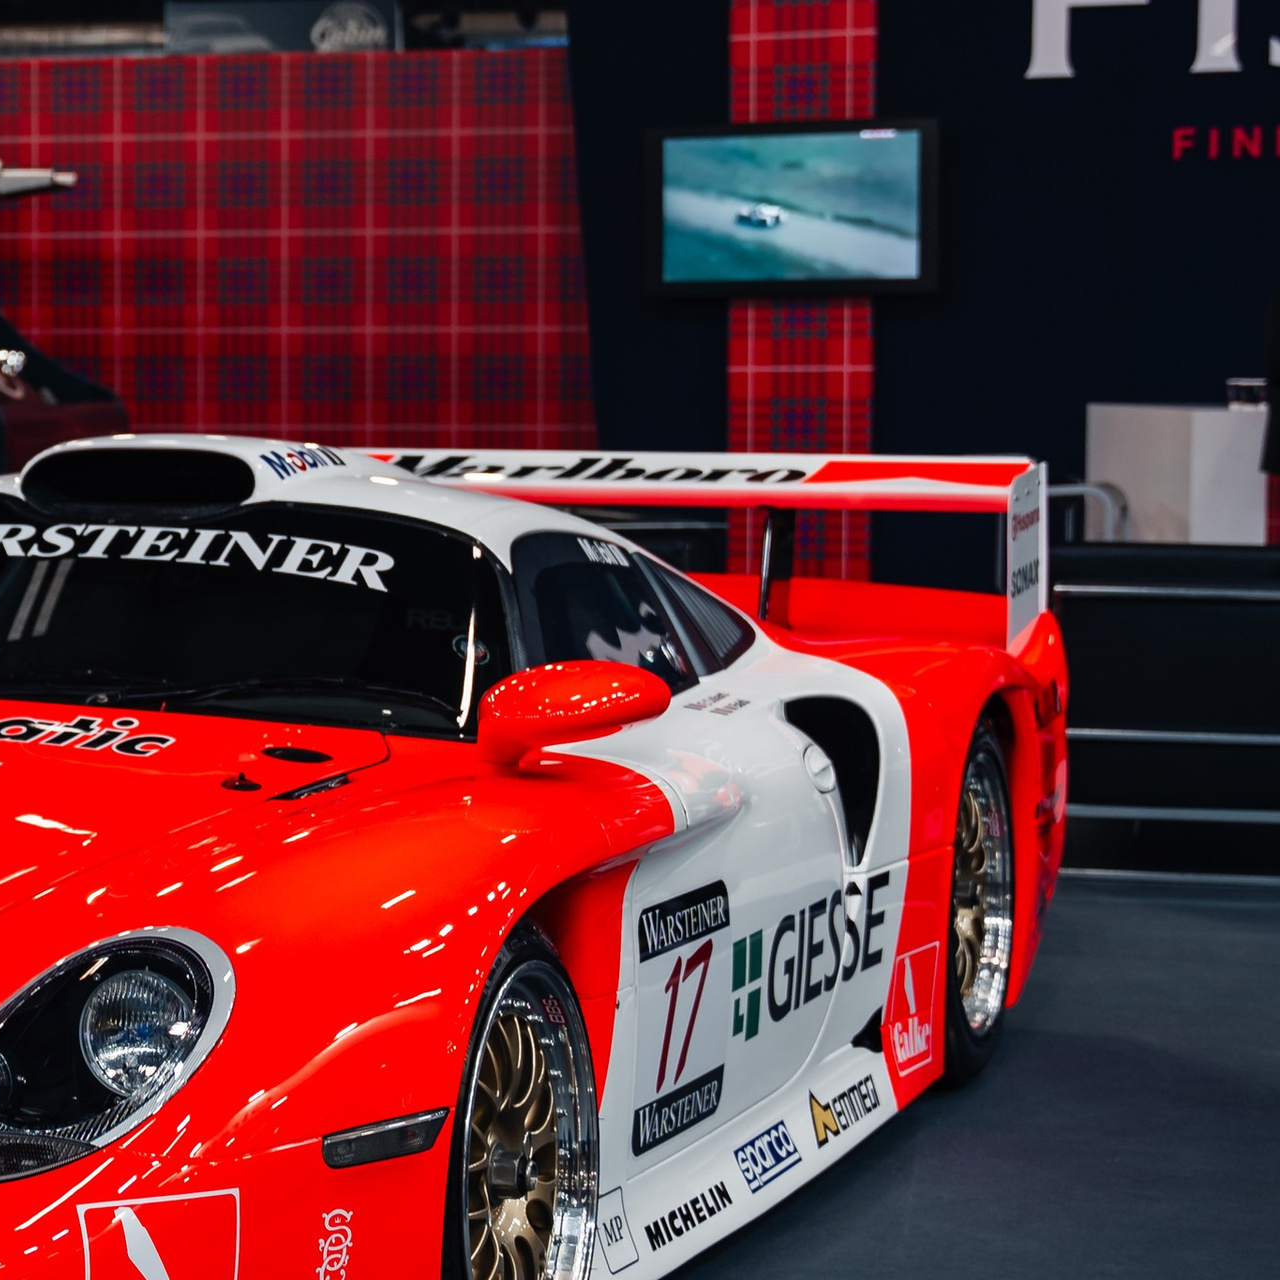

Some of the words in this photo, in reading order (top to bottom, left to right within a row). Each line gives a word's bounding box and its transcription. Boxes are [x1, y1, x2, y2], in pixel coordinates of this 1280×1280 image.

[1172, 125, 1280, 161] FIN
[393, 455, 808, 485] Marlboro
[1010, 558, 1040, 599] SONAX
[641, 895, 727, 954] WARSTEINER
[767, 870, 891, 1023] GIESSE
[655, 938, 714, 1095] 17
[893, 1016, 930, 1064] falke
[637, 1084, 718, 1148] WARSTEINER
[828, 1074, 882, 1131] EMMEGI
[735, 1124, 796, 1186] sparco
[602, 1214, 625, 1248] MP
[643, 1181, 733, 1252] MICHELIN
